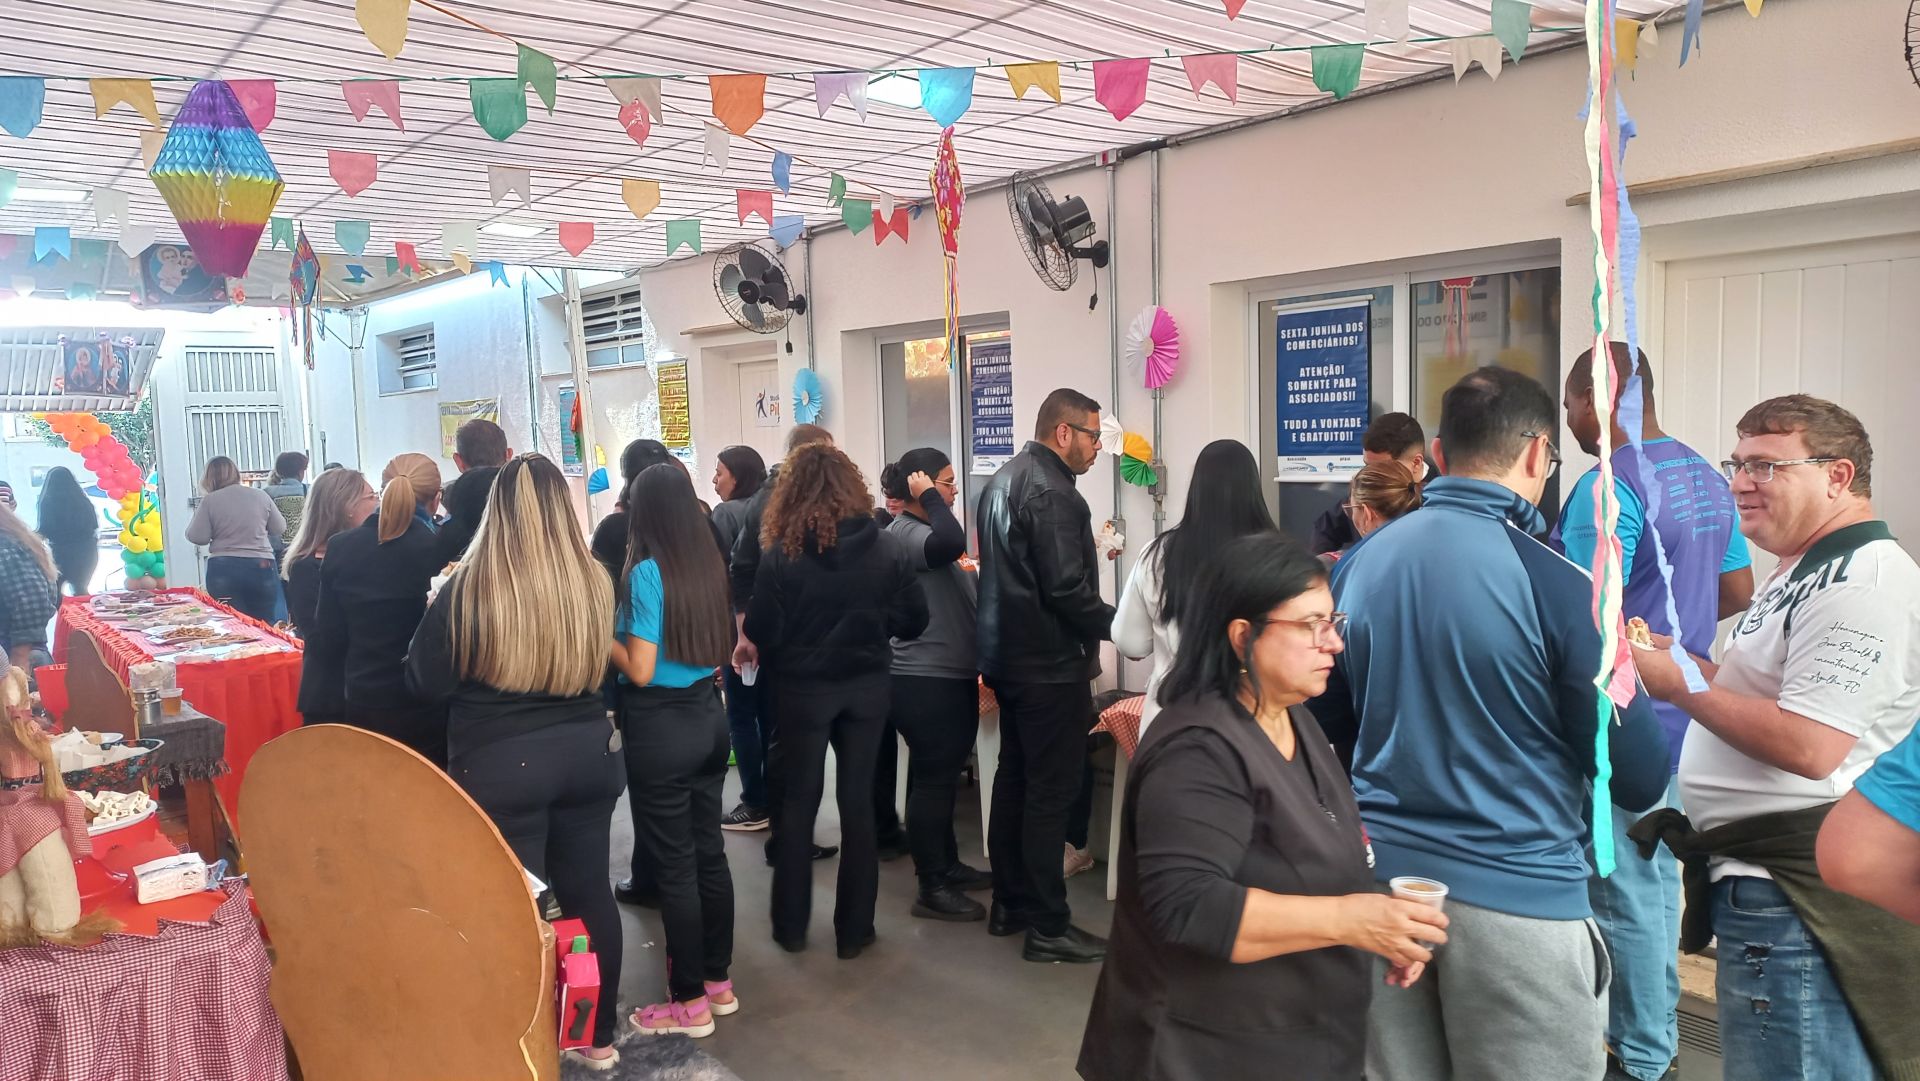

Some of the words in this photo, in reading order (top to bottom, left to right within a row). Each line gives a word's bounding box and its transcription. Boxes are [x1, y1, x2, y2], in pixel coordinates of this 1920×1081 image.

[1281, 327, 1308, 339] SEXTA
[1311, 324, 1342, 337] JUNINA
[1346, 322, 1364, 333] DOS
[1286, 336, 1358, 351] COMERCIÁRIOS!
[975, 365, 1012, 375] COMERCIÁRIO
[1299, 364, 1345, 378] ATENÇÃO!
[1287, 379, 1331, 391] SOMENTE
[1333, 377, 1357, 389] PARA
[977, 396, 1001, 406] SOMENTE
[1288, 391, 1356, 404] ASSOCIADOS!!
[978, 406, 1012, 416] ASSOCIADOS
[1283, 419, 1308, 430] TUDO
[1311, 419, 1317, 429] A
[1320, 417, 1362, 429] VONTADE
[996, 426, 1013, 435] VONT
[984, 436, 1013, 445] GRATUITO
[1292, 432, 1297, 443] E
[1300, 431, 1353, 442] GRATUITO!!
